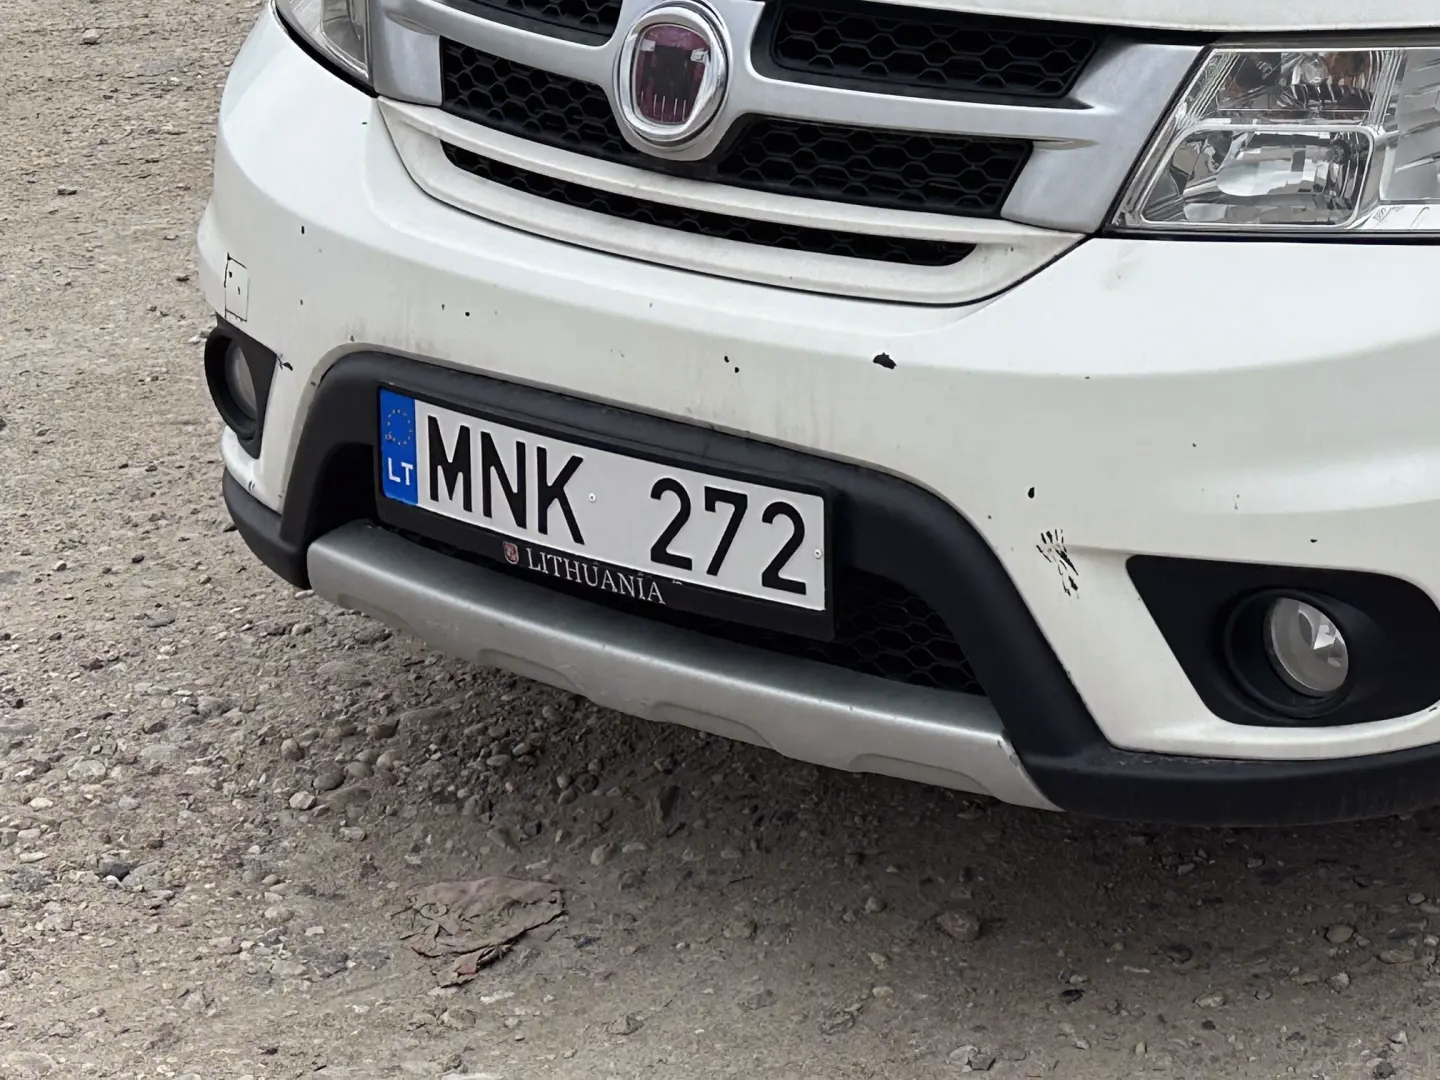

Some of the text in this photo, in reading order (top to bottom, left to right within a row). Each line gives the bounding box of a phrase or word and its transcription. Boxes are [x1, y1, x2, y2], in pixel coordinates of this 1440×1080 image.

[387, 457, 414, 487] LT
[427, 415, 807, 596] MNK 272
[525, 547, 666, 605] LITHUANIA
